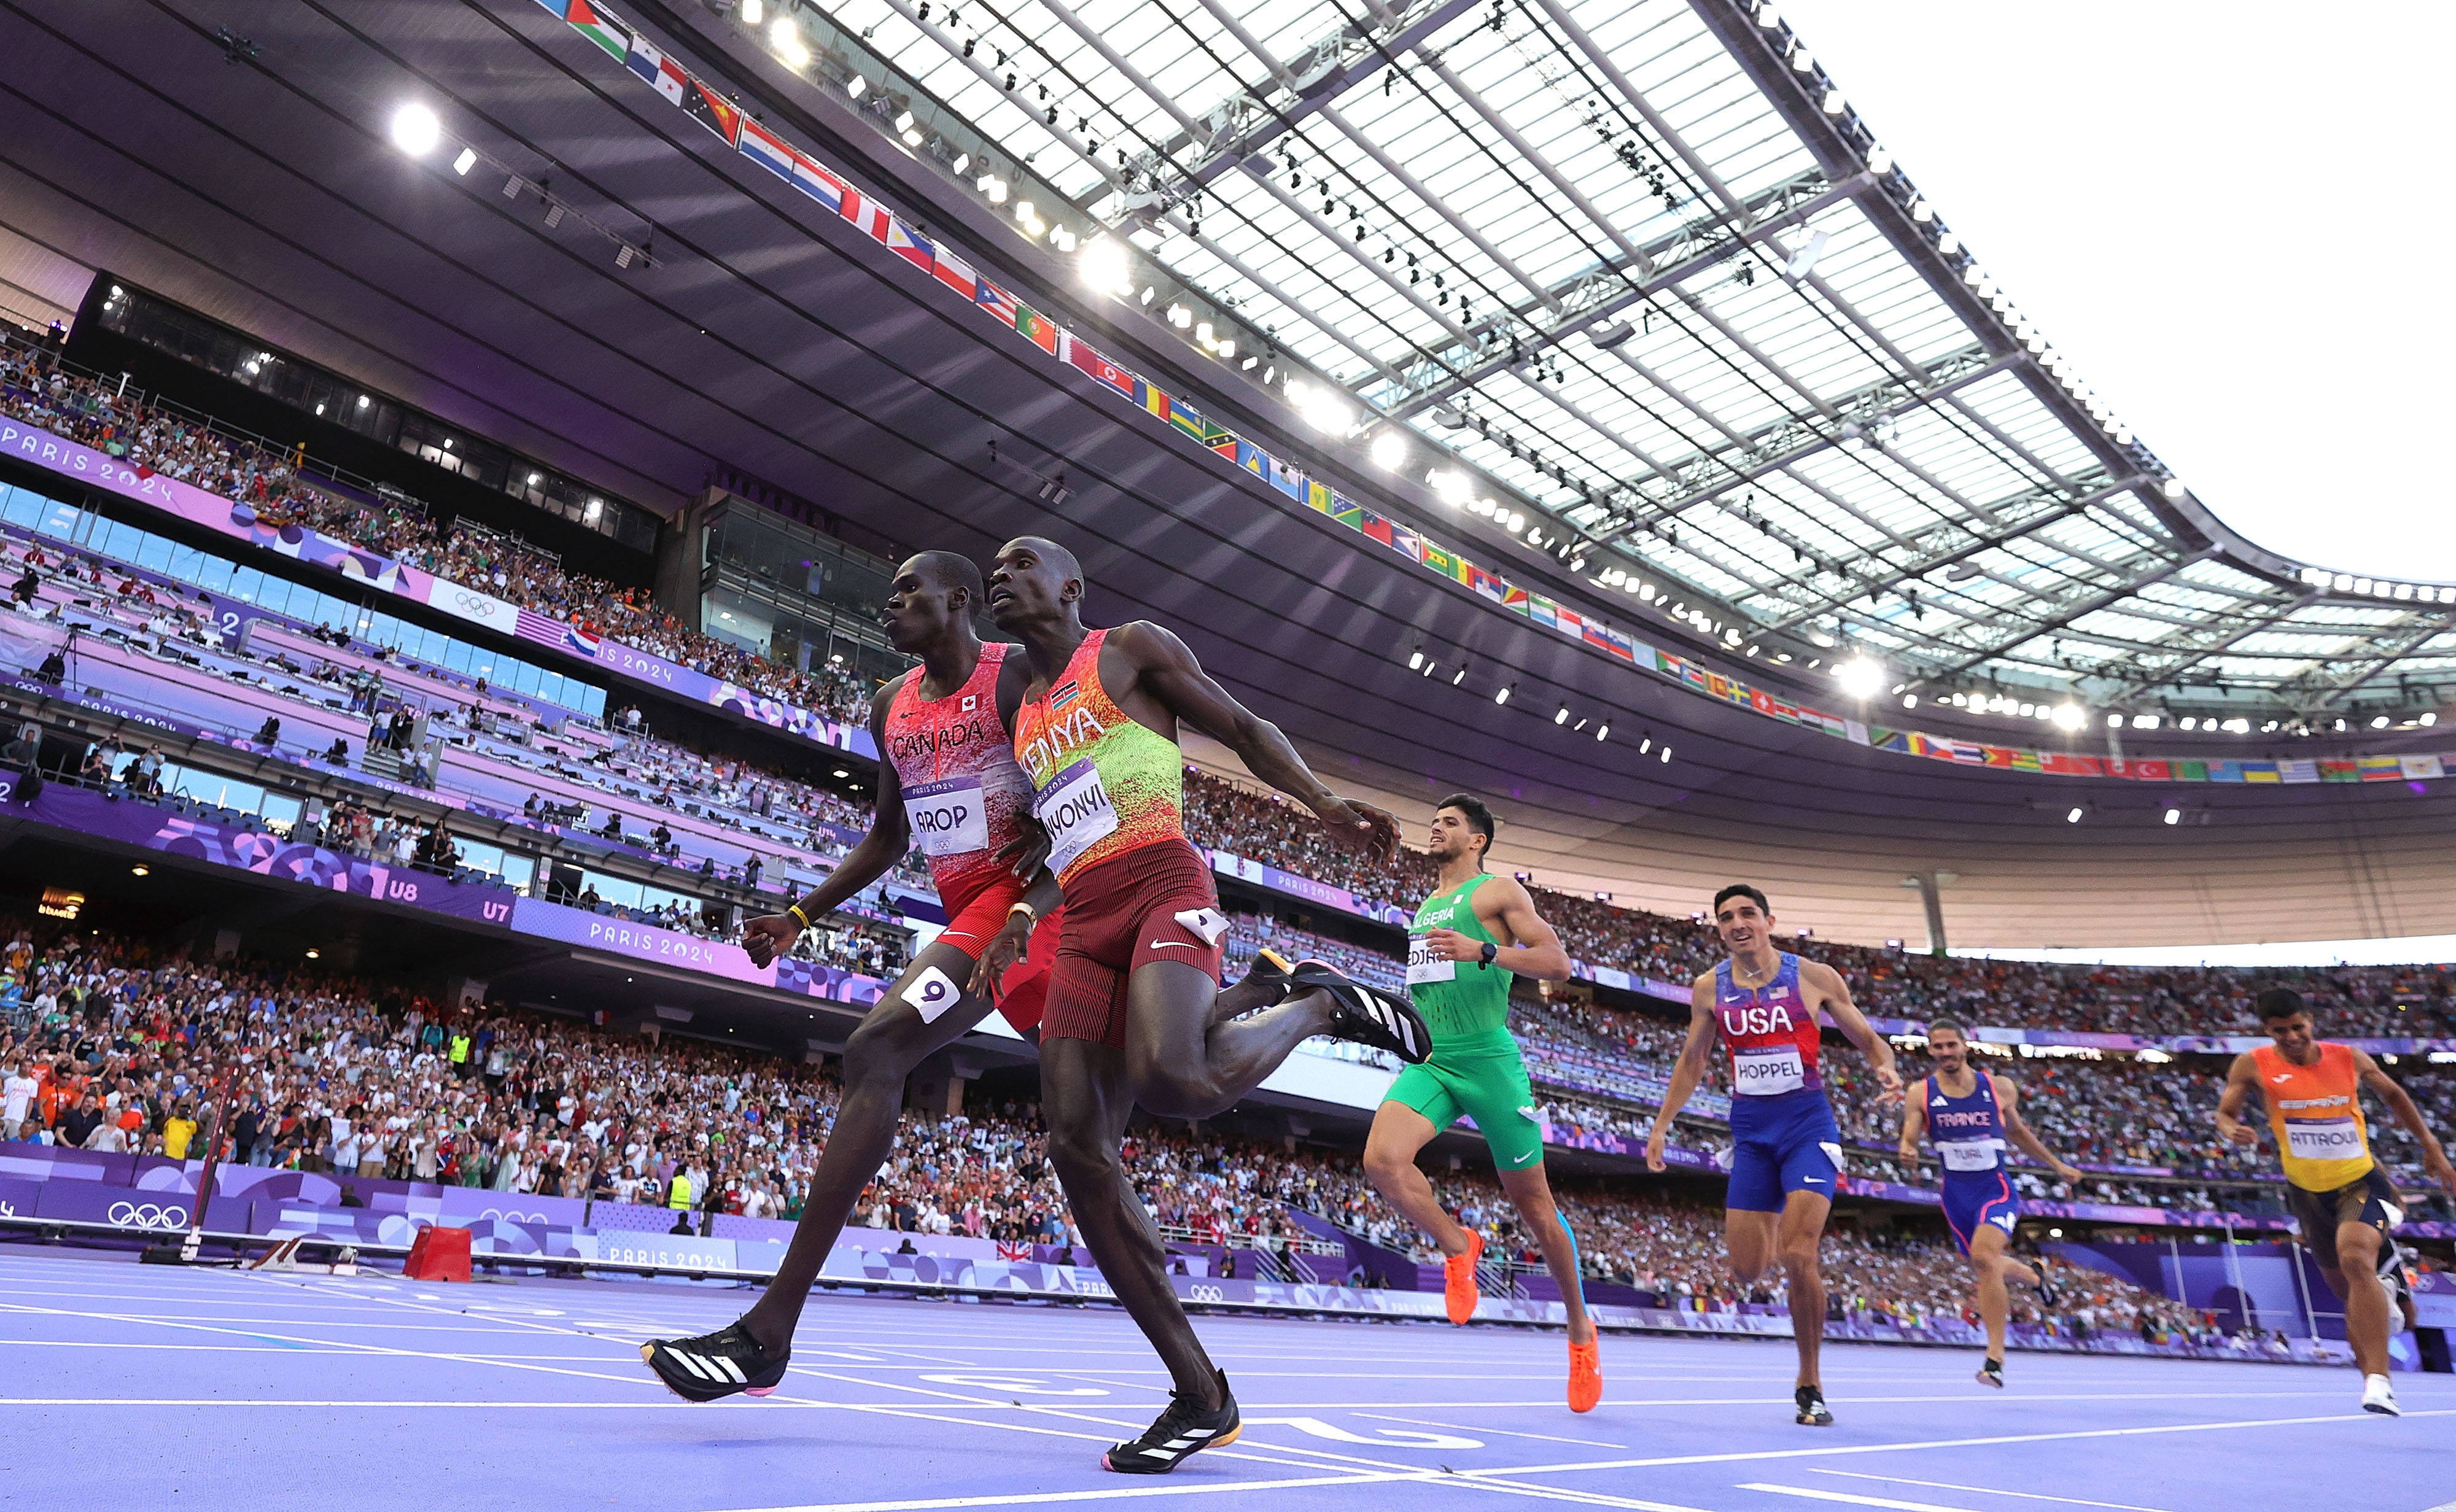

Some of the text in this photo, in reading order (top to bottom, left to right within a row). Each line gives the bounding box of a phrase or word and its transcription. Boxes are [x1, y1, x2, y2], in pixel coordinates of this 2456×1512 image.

[2, 427, 172, 500] PARIS 2024
[221, 613, 240, 637] 2
[560, 632, 672, 683] PIS 2024
[893, 720, 984, 760] CANADA
[1019, 707, 1105, 785] KENYA
[912, 782, 954, 795] PARIS 2024
[1048, 775, 1068, 793] 2024
[915, 805, 968, 833] AROP
[1045, 783, 1106, 840] NYONYI
[389, 880, 418, 902] U8
[1278, 875, 1308, 893] PARIS
[483, 901, 510, 922] U7
[1413, 907, 1454, 929] ALGERIA
[590, 922, 713, 964] PARIS 2024
[922, 980, 946, 1002] 9
[1723, 1005, 1793, 1036] USA
[1738, 1061, 1800, 1079] HOPPEL
[1936, 1111, 1991, 1127] FRANCE
[610, 1247, 726, 1270] PARIS 2024
[1082, 1281, 1112, 1295] PAR
